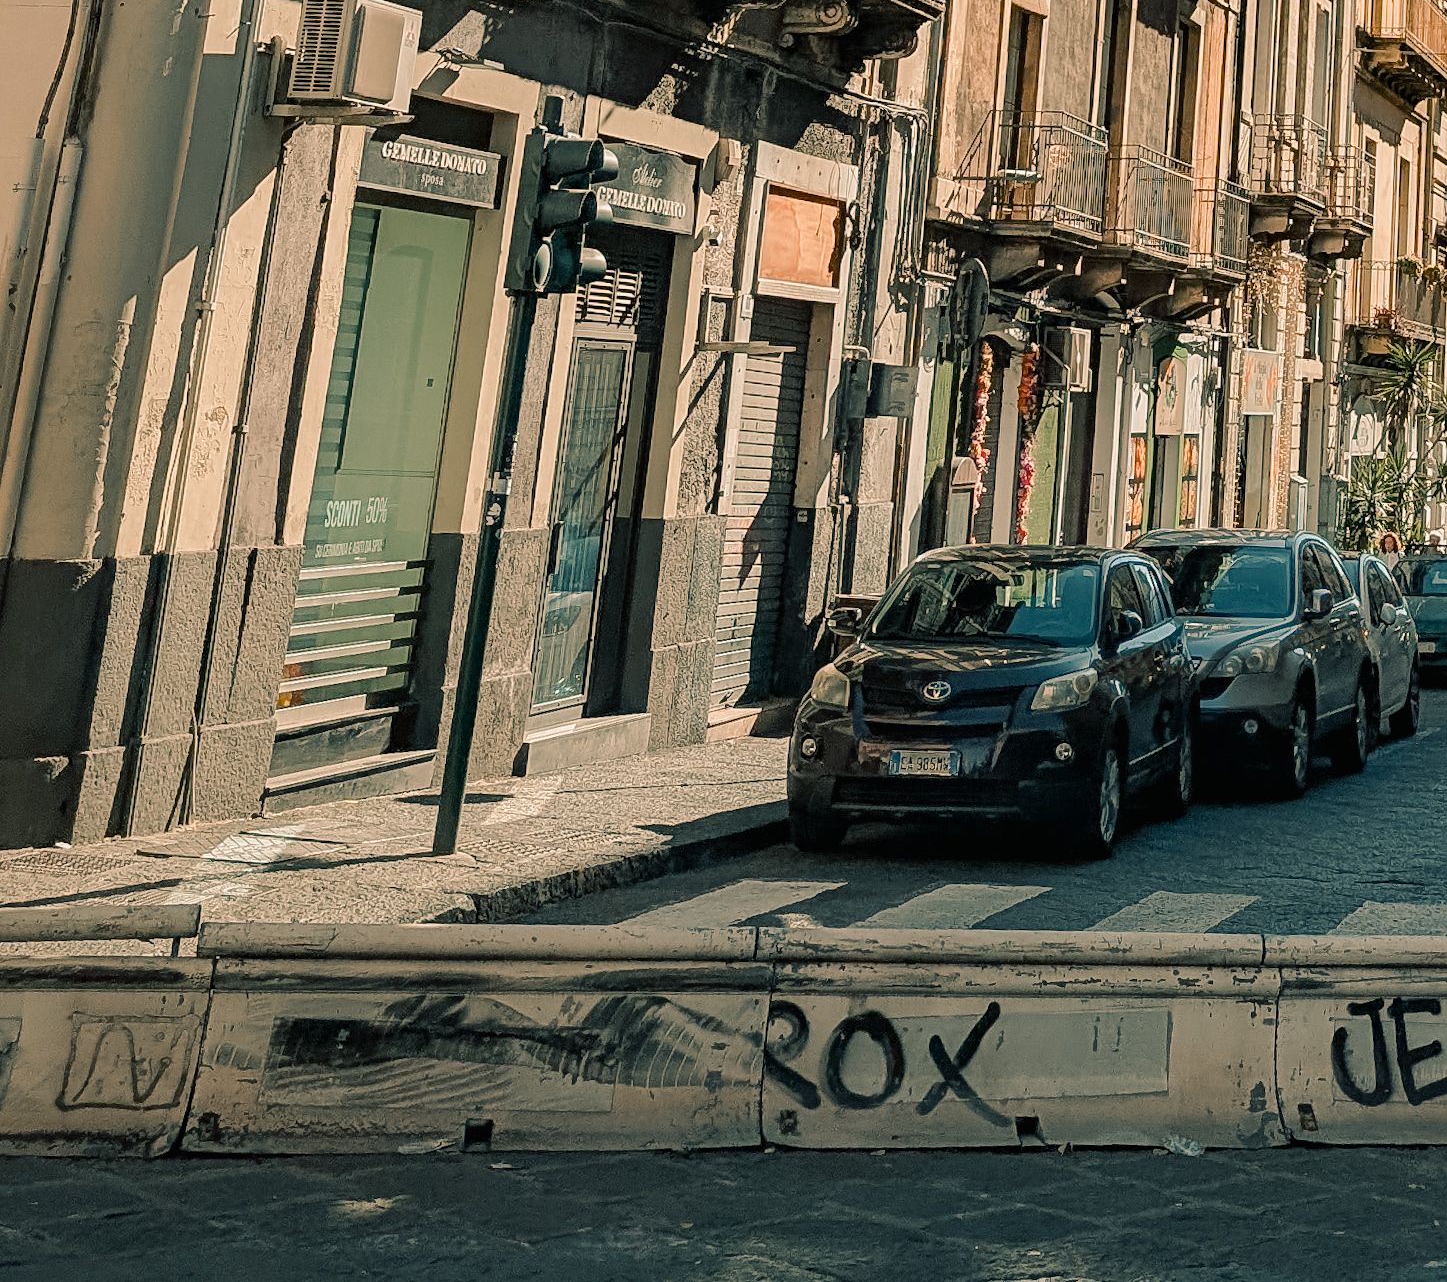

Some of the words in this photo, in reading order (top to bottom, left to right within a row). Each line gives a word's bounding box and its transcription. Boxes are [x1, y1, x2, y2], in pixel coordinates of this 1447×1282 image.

[382, 140, 441, 168] GEMELLE
[421, 172, 444, 188] sposa
[324, 499, 361, 529] SCONTI
[365, 496, 389, 525] 50%
